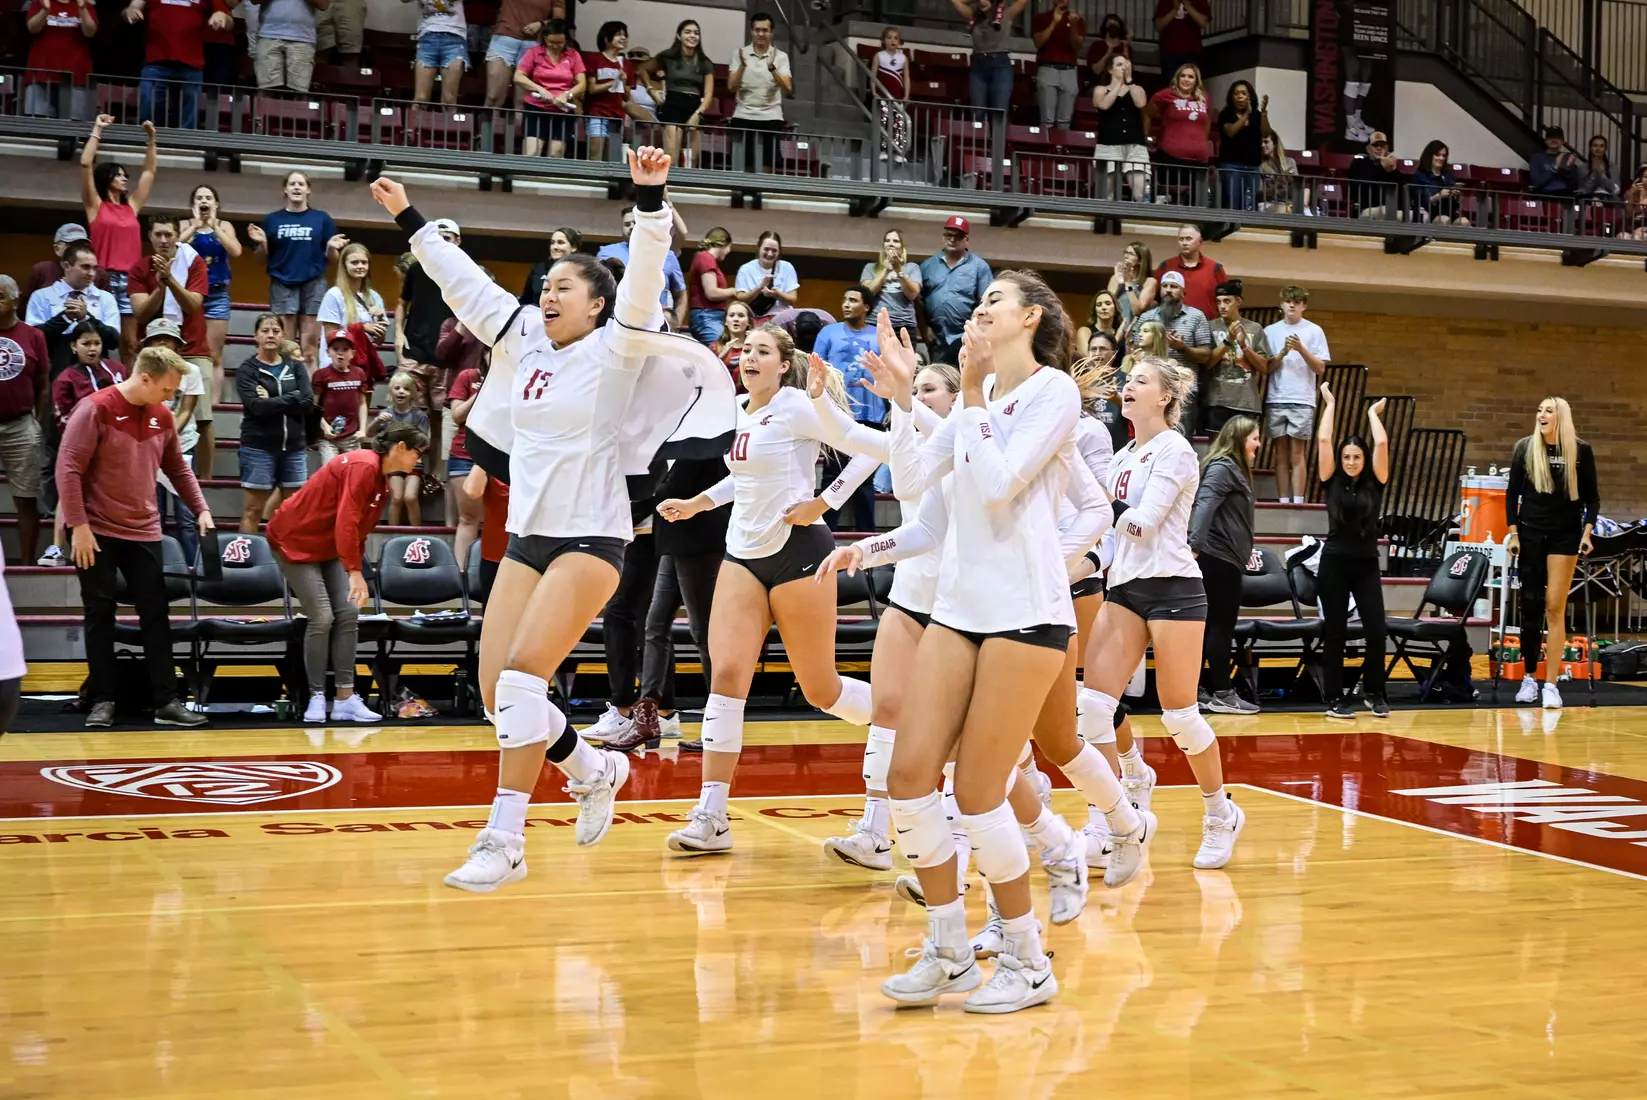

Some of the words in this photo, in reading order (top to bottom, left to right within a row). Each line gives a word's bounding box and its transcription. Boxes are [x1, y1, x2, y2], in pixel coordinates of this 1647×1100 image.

[1353, 33, 1369, 41] BEEN
[1370, 35, 1388, 43] SINCE
[277, 226, 313, 239] FIRST
[729, 432, 751, 461] 10
[830, 478, 845, 493] WSU
[1114, 470, 1132, 500] 19
[1126, 522, 1142, 538] WSU
